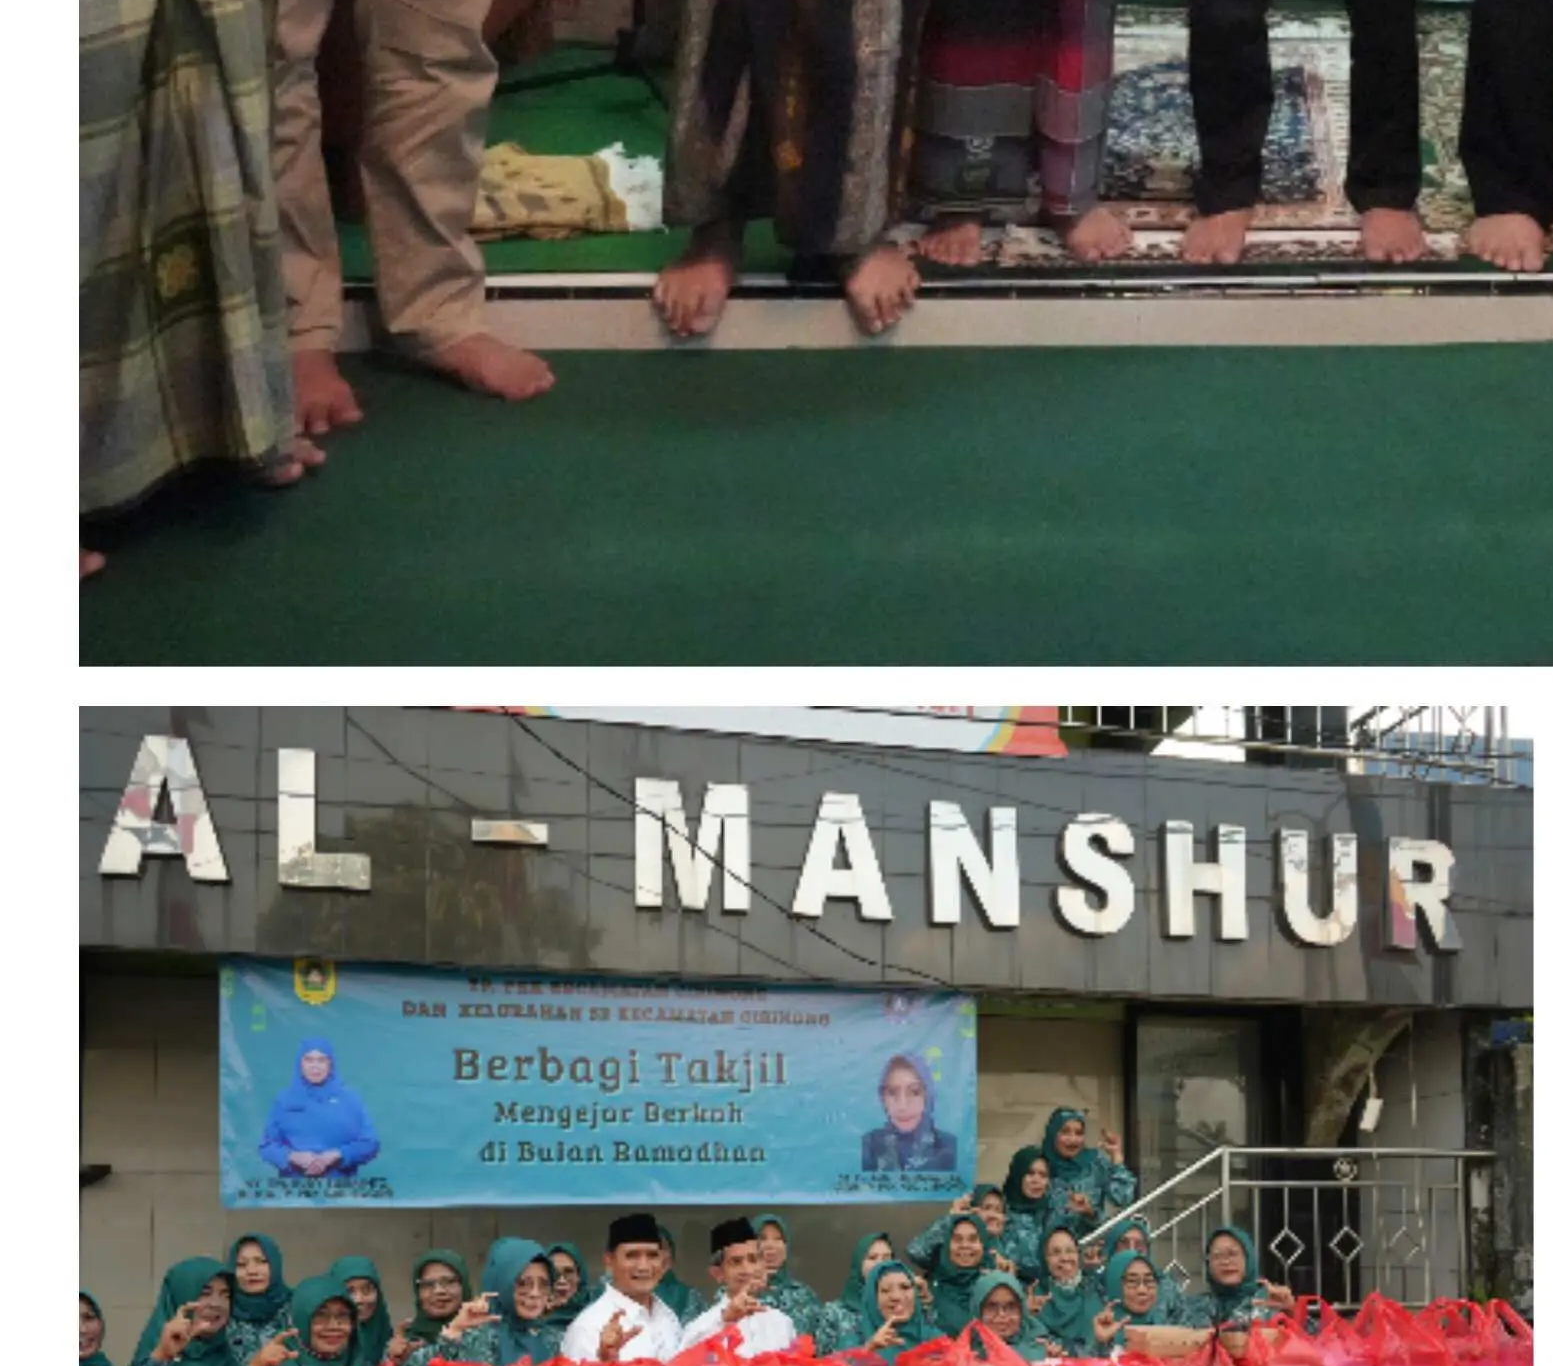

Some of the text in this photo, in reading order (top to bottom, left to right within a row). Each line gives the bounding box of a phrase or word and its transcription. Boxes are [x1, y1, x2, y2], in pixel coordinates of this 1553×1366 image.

[100, 735, 371, 893] AL
[633, 777, 1462, 954] MANSHUR
[401, 1000, 447, 1019] DAN
[458, 1003, 582, 1022] KELURAHAN
[452, 1047, 788, 1094] Berbagi Takjil
[493, 1101, 744, 1130] Mengejar Berkah
[479, 1140, 767, 1164] di Bulan Ramadhan
